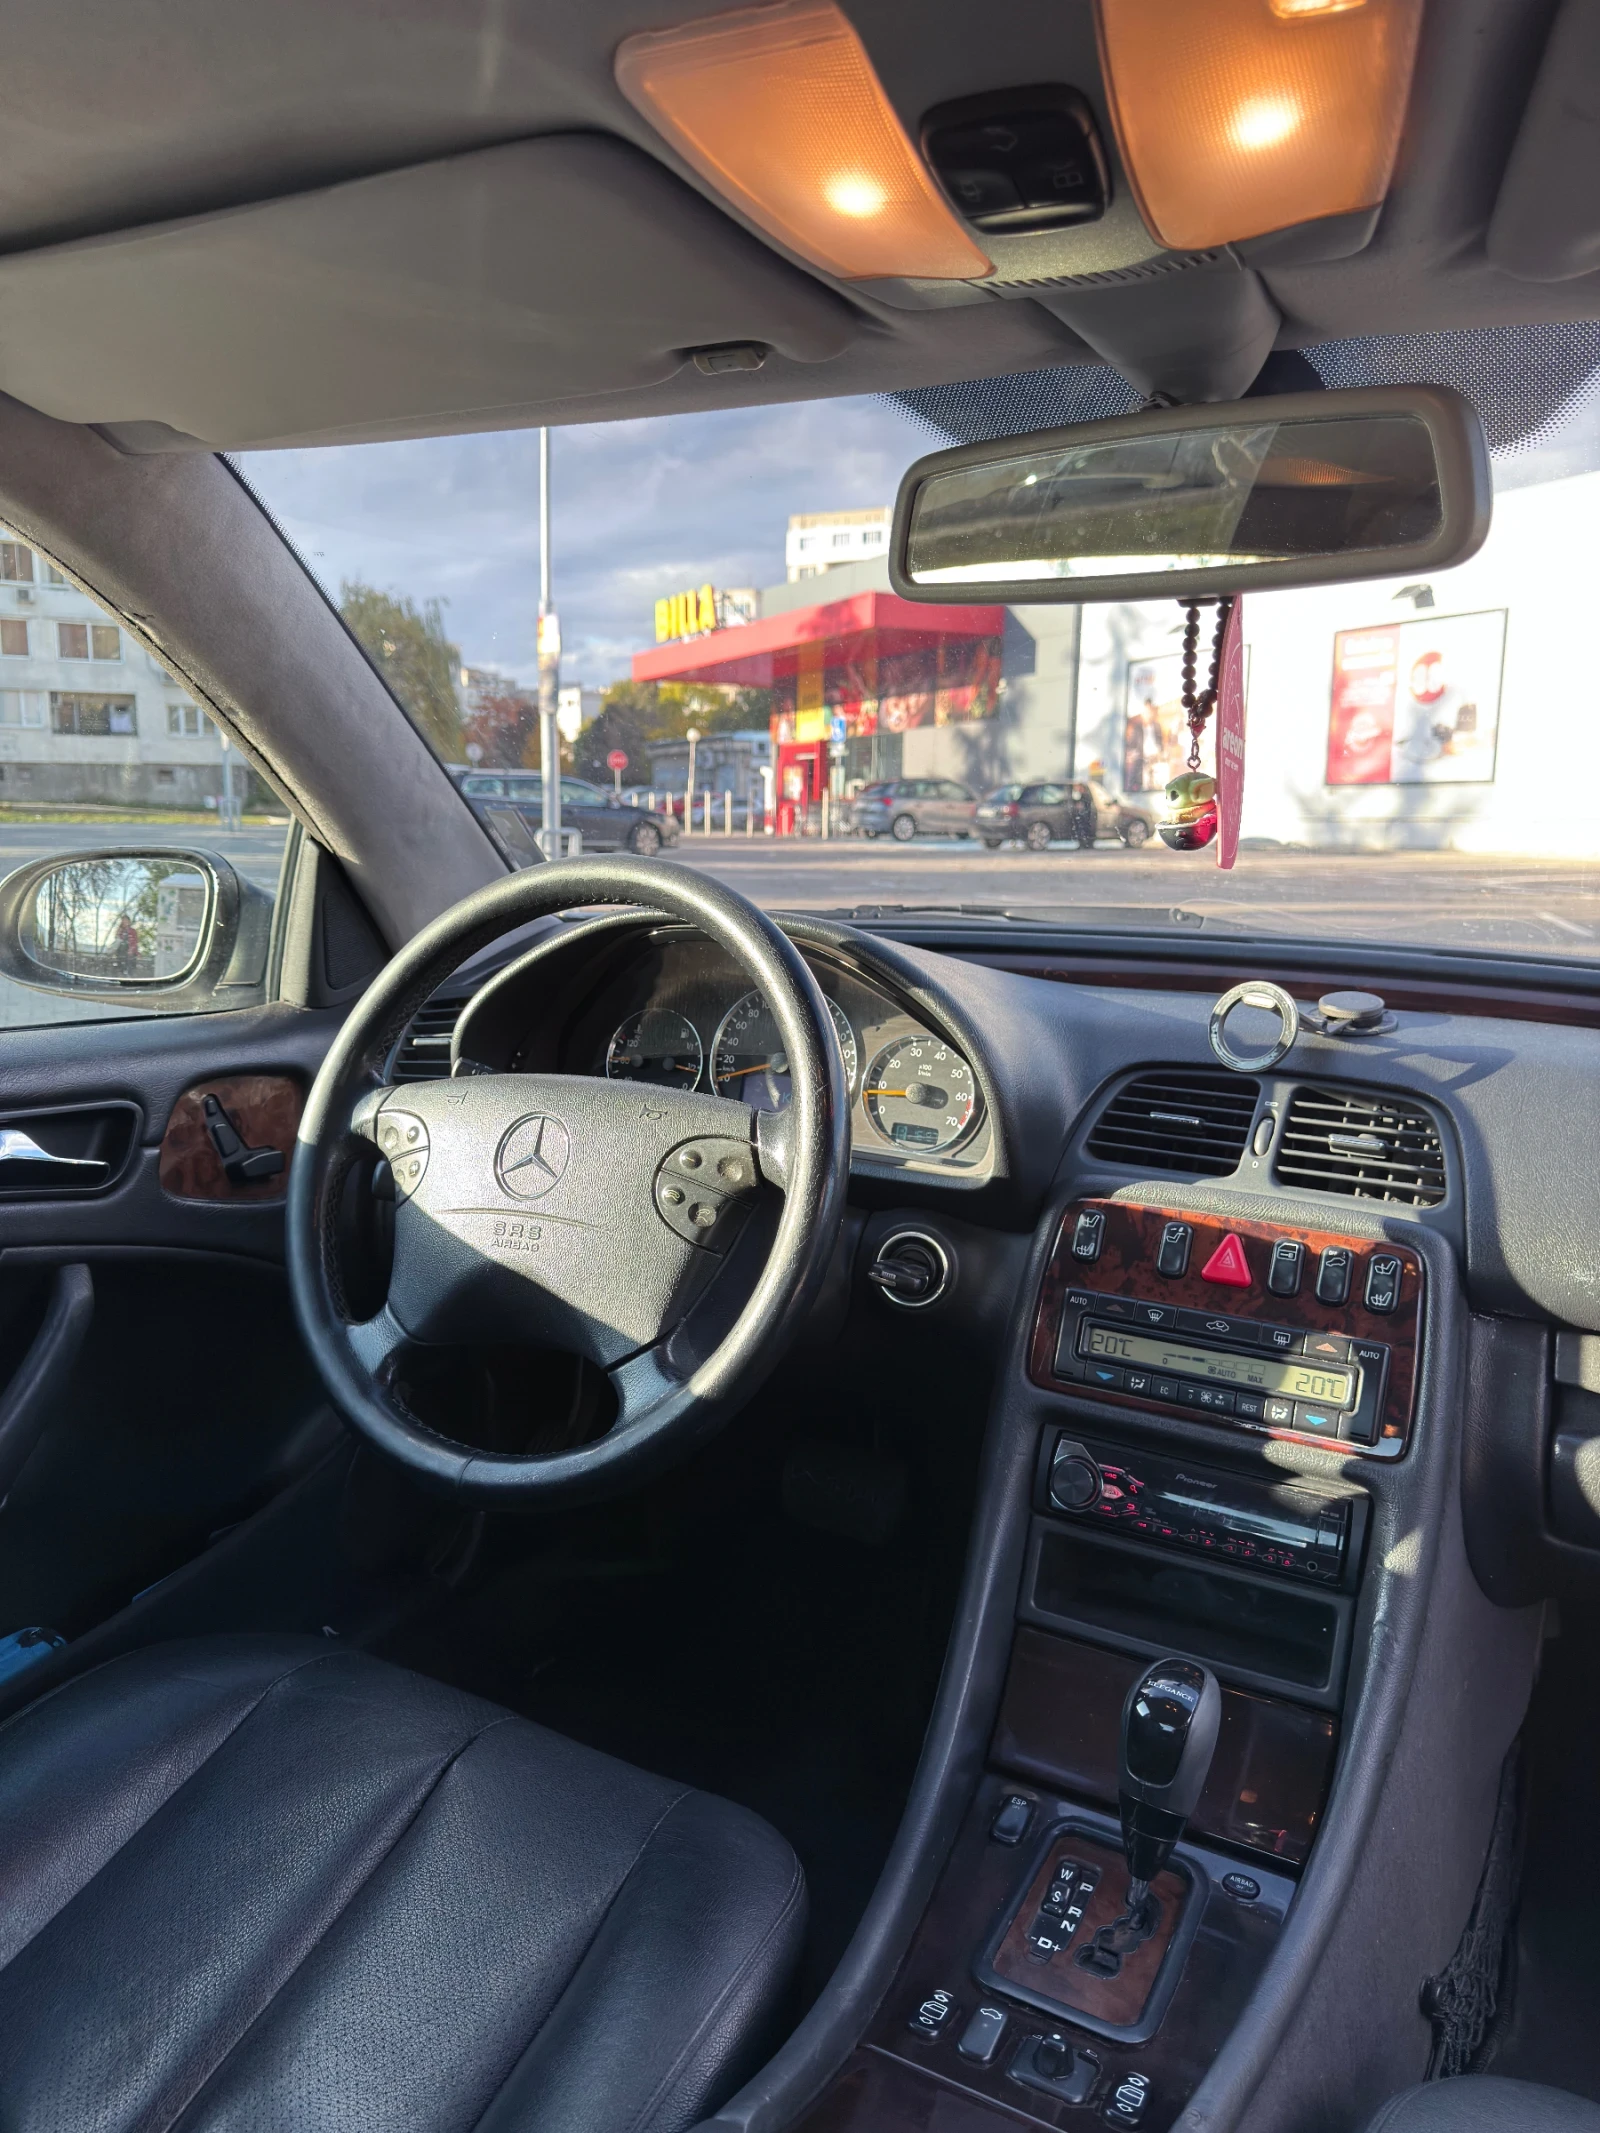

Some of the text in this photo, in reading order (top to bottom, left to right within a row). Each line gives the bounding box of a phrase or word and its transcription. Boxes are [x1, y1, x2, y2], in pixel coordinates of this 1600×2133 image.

[655, 584, 715, 643] BILLA
[1222, 727, 1244, 760] areon
[748, 1009, 759, 1018] 80
[736, 1021, 747, 1030] 60
[627, 1040, 638, 1048] 120
[727, 1037, 739, 1046] 40
[910, 1048, 922, 1057] 30
[934, 1051, 947, 1061] 40
[724, 1054, 735, 1063] 20
[889, 1059, 901, 1069] 20
[951, 1069, 963, 1078] 50
[878, 1080, 887, 1089] 10
[955, 1092, 968, 1102] 60
[879, 1105, 886, 1114] 0
[945, 1116, 958, 1126] 70
[493, 1220, 542, 1240] SRS
[491, 1238, 540, 1253] AIRBAG
[1069, 1295, 1088, 1306] AUTO
[1358, 1349, 1380, 1360] AUTO
[1216, 1369, 1263, 1384] AUTO MAX
[1160, 1386, 1169, 1395] EC
[1241, 1402, 1258, 1413] REST
[1175, 1473, 1218, 1490] Pioneer
[1011, 1796, 1027, 1806] ESP
[1060, 1867, 1074, 1881] W
[1230, 1875, 1254, 1888] AIRBAG
[1079, 1882, 1093, 1892] P
[1052, 1891, 1062, 1903] S
[1067, 1906, 1082, 1918] R
[1060, 1920, 1075, 1933] N
